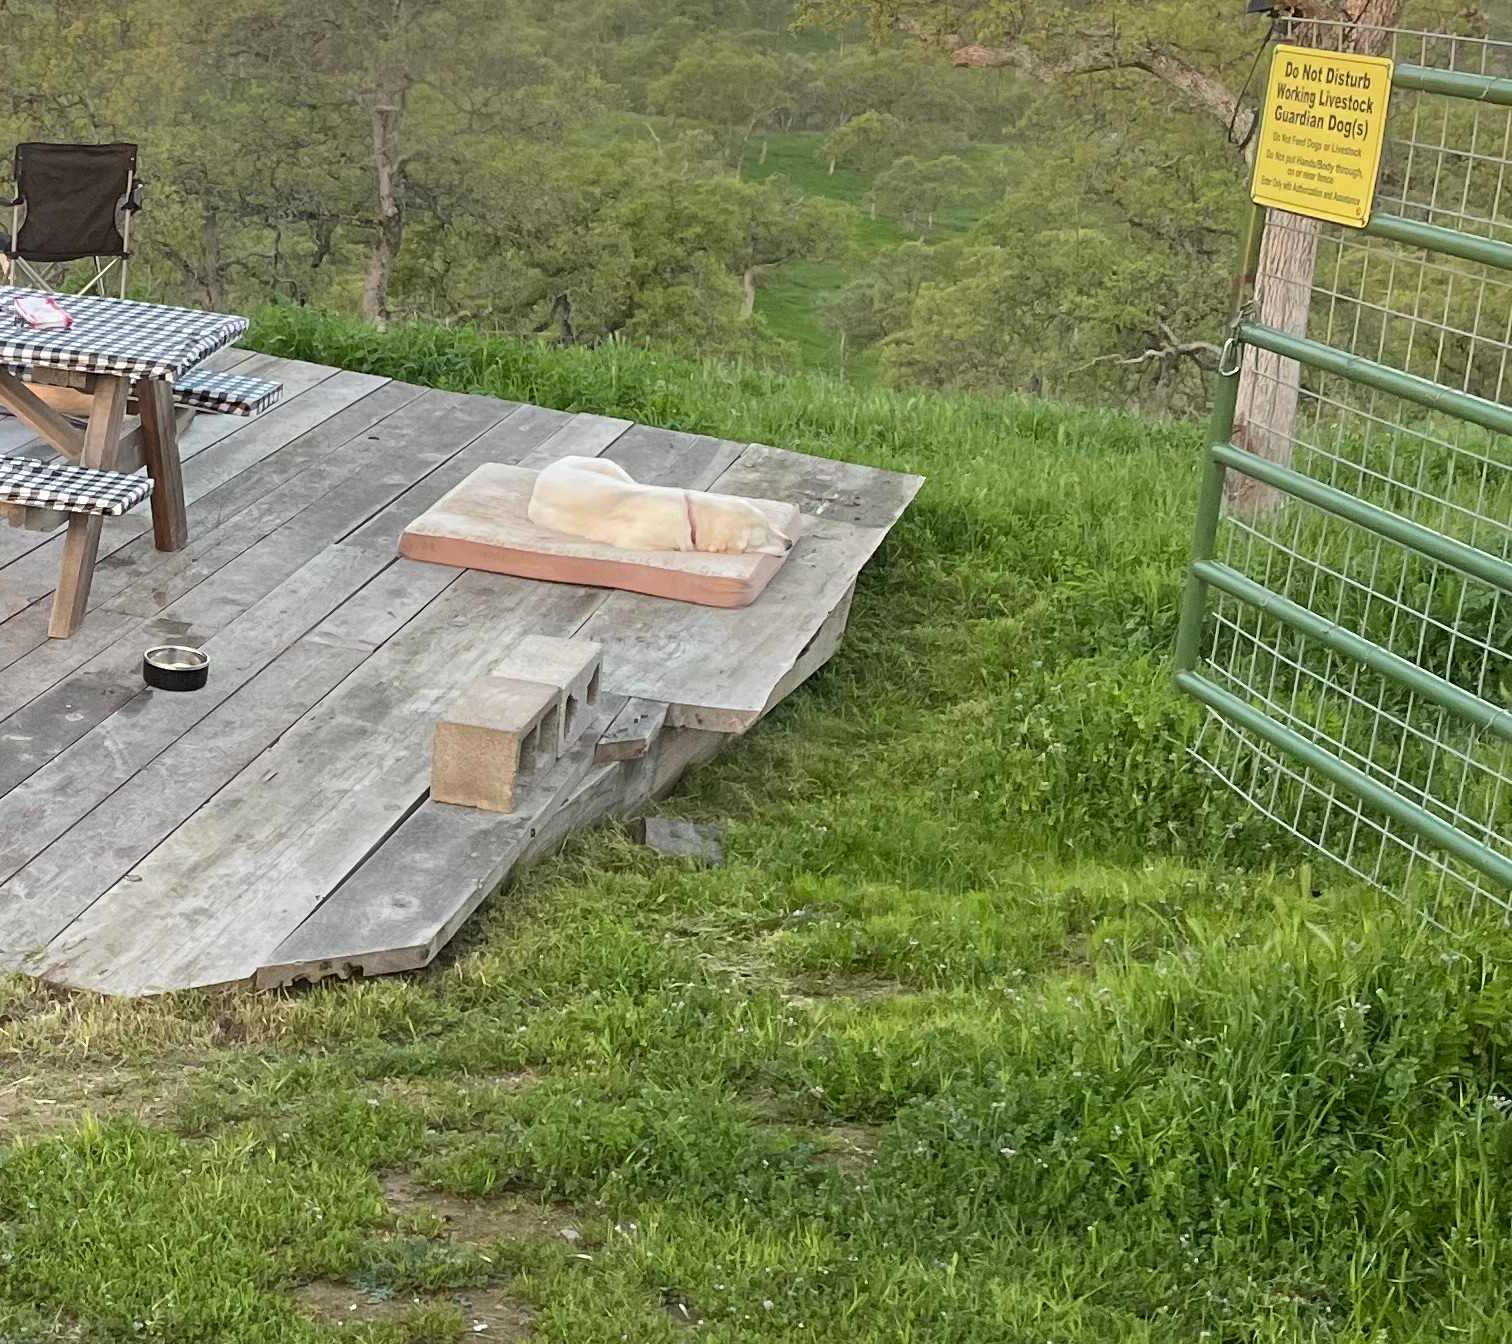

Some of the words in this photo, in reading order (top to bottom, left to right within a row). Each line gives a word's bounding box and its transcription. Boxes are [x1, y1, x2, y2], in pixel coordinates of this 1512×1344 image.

[1285, 61, 1299, 79] Do
[1302, 64, 1323, 82] Not
[1325, 67, 1371, 89] Disturb
[1276, 82, 1316, 109] Working
[1318, 90, 1374, 114] Livestock
[1275, 105, 1324, 129] Guardian
[1328, 115, 1369, 141] Dog(s)
